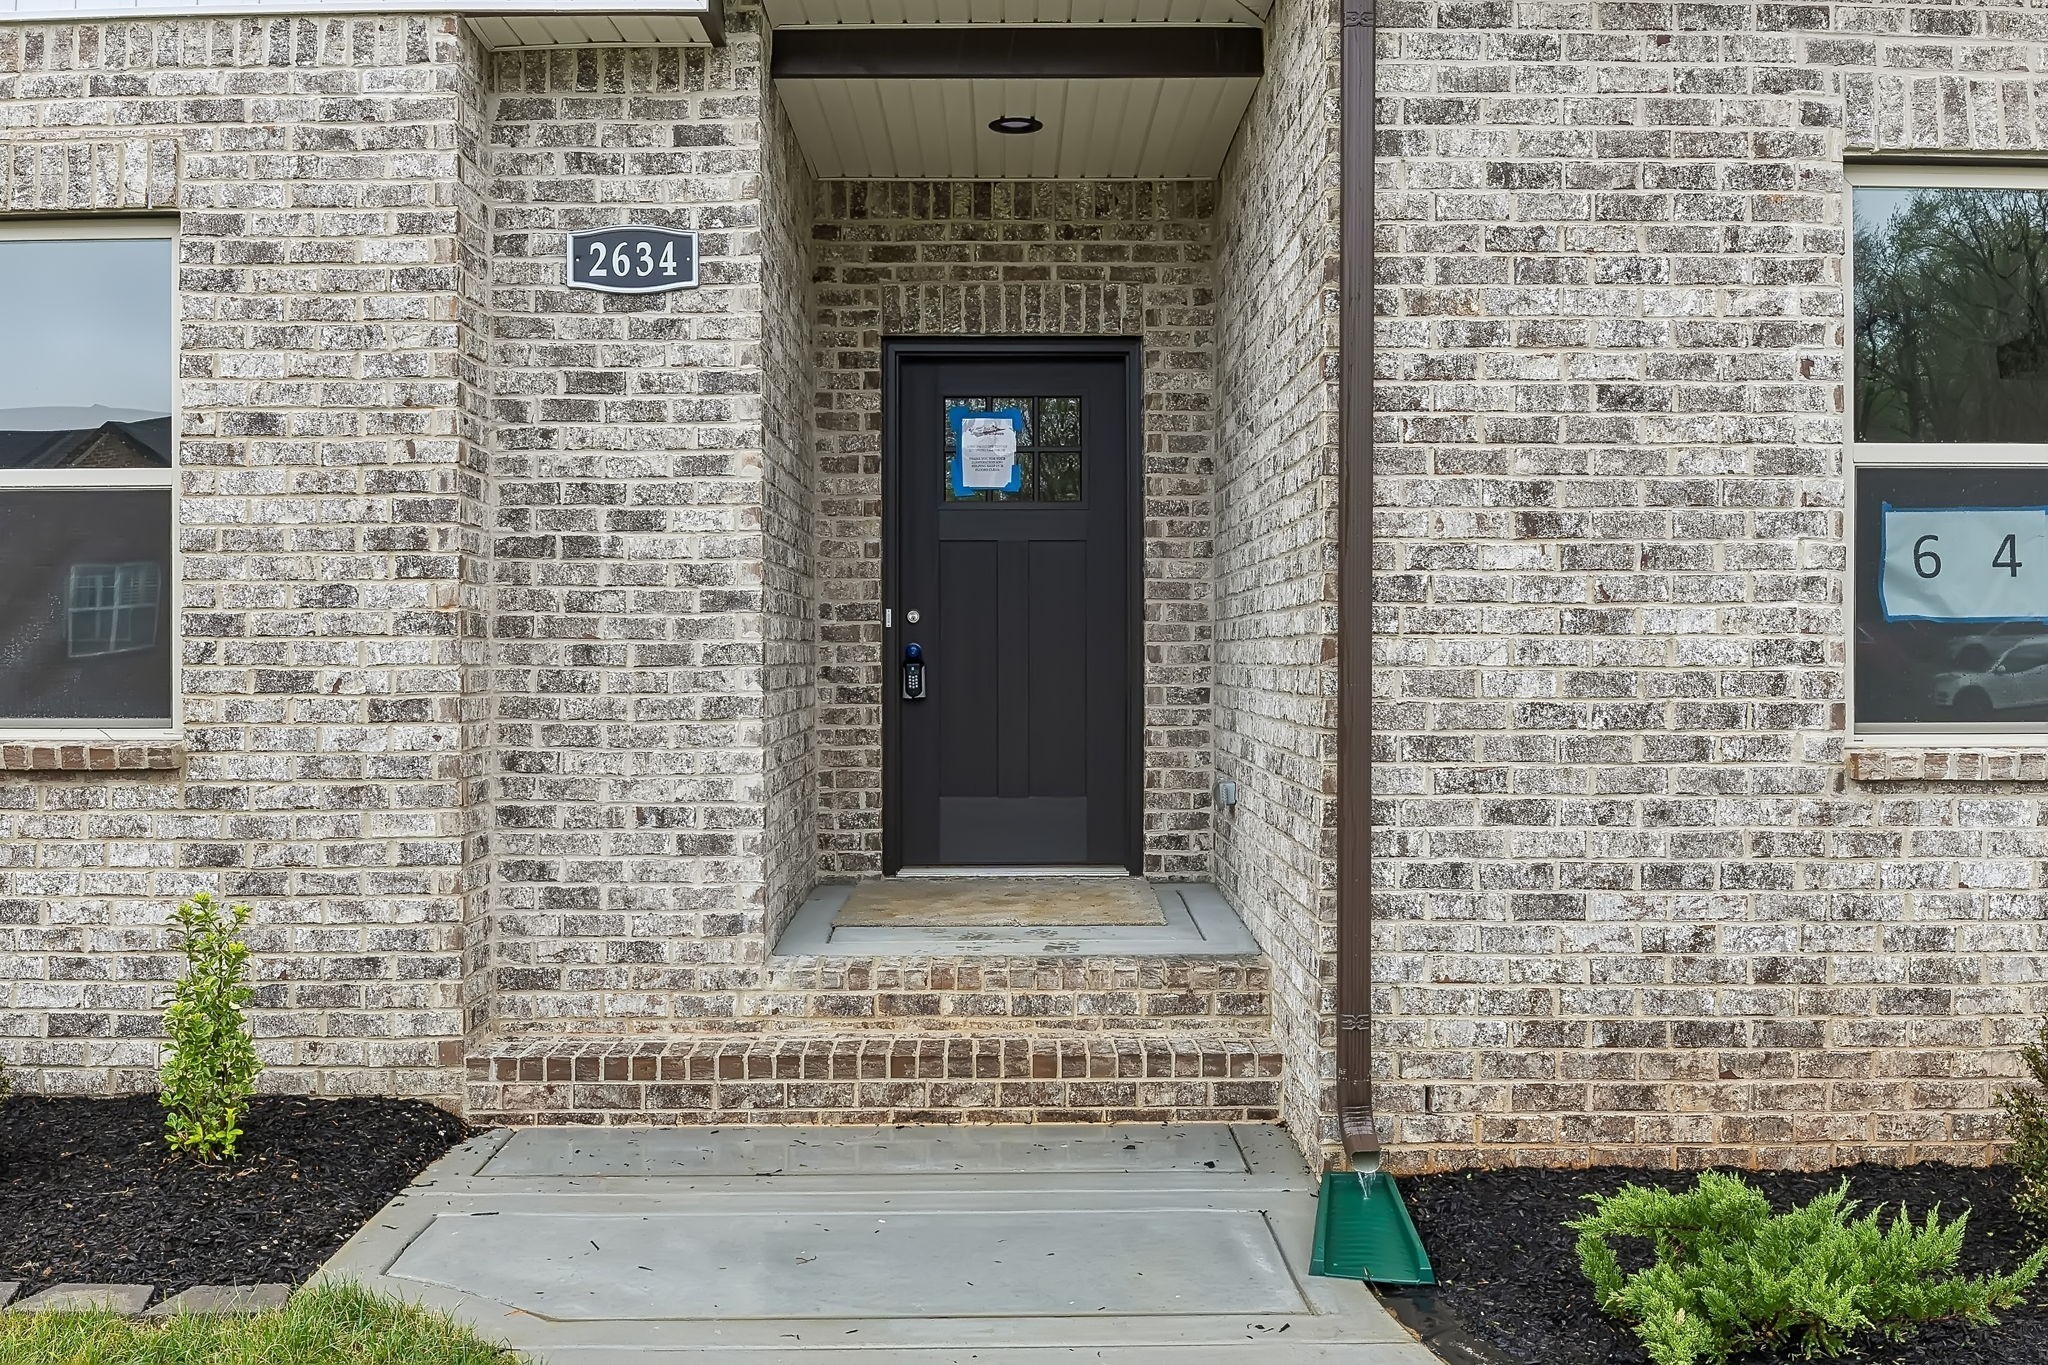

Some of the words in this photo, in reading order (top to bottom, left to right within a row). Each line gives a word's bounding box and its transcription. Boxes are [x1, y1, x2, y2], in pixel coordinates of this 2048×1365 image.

[589, 241, 677, 277] 2634
[1913, 535, 1941, 578] 6
[1992, 534, 2022, 577] 4
